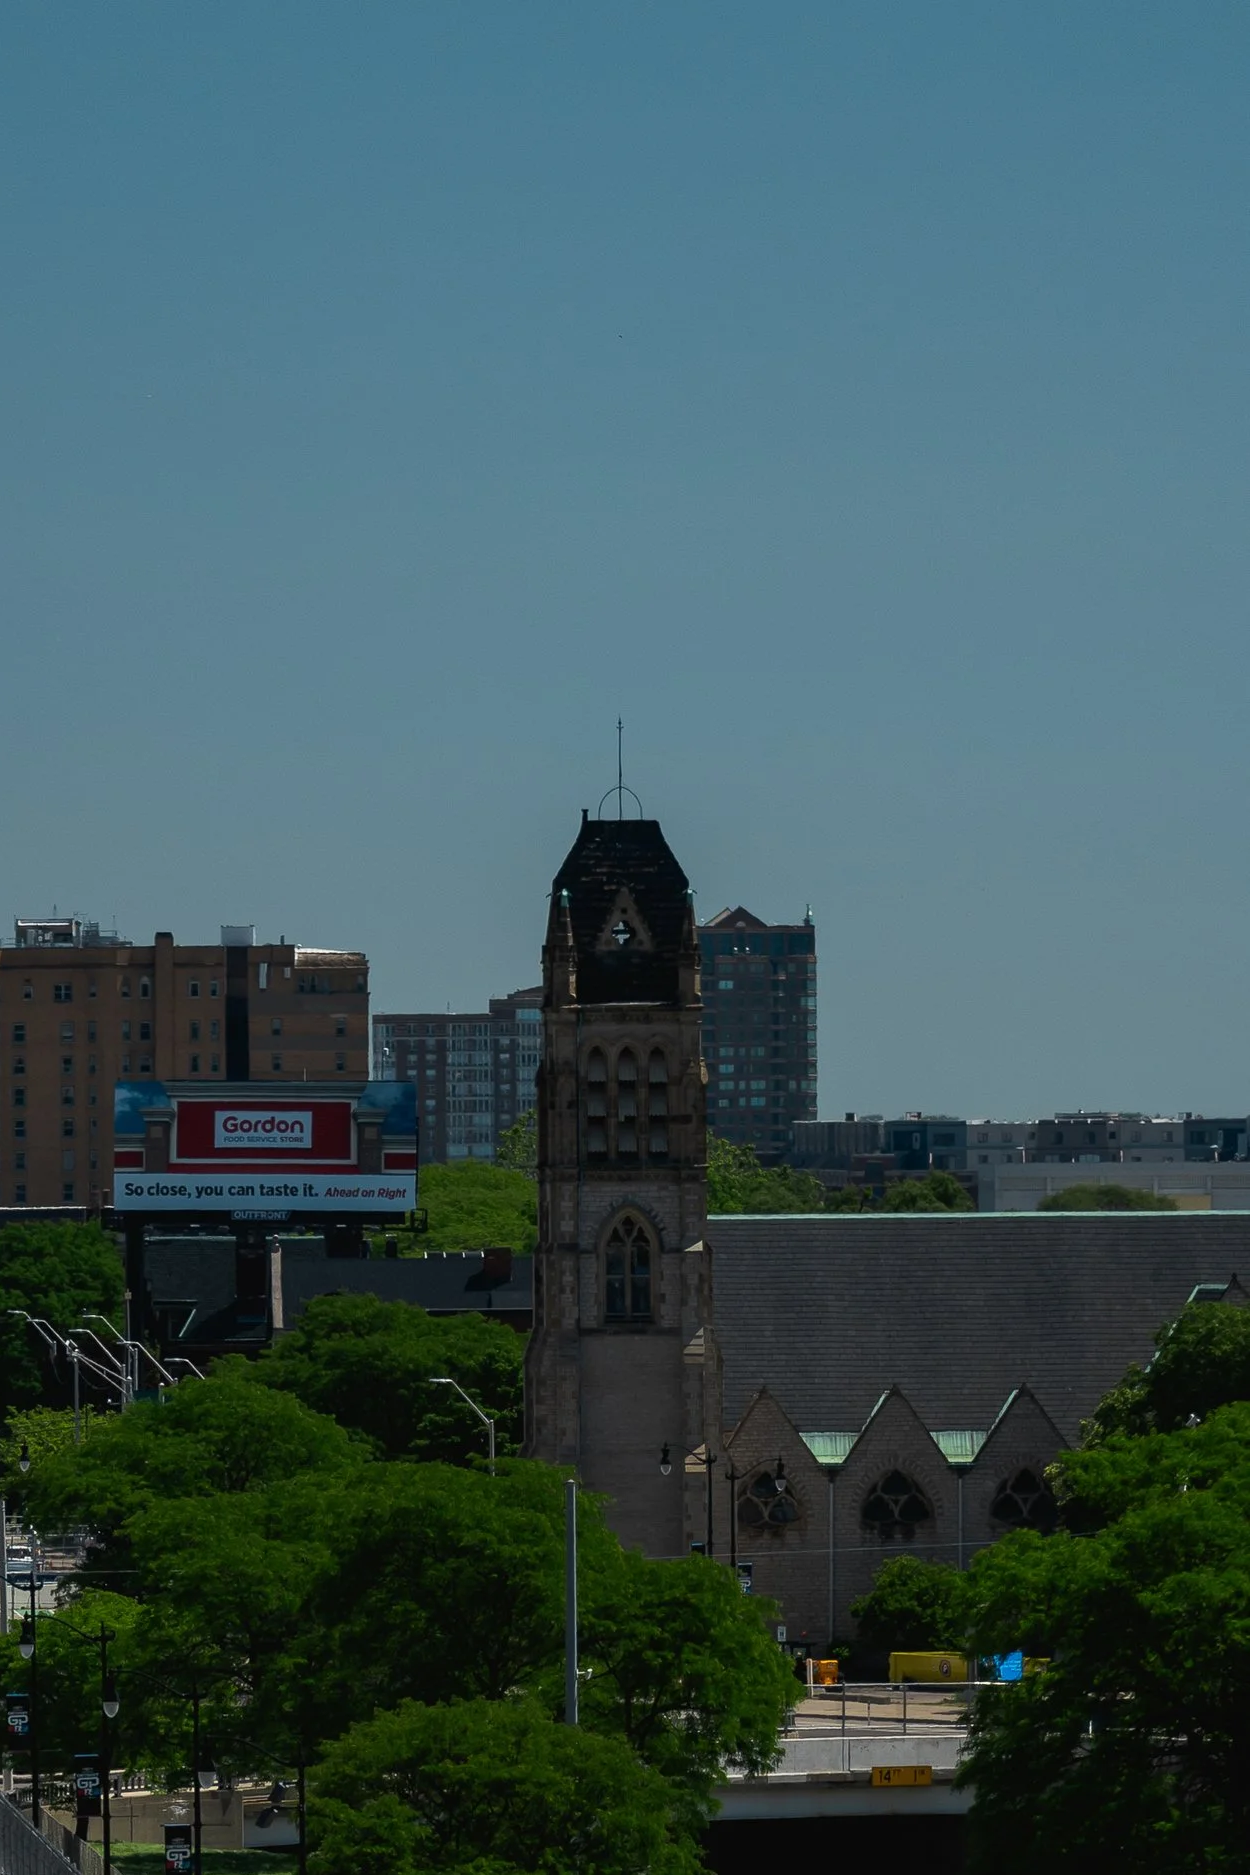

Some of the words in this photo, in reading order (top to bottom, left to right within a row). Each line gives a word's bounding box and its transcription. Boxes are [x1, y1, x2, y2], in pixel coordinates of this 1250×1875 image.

[222, 1115, 305, 1134] Gordon
[124, 1182, 144, 1196] So
[147, 1182, 192, 1198] close,
[195, 1185, 224, 1199] you
[228, 1185, 255, 1196] can
[259, 1183, 298, 1196] taste
[302, 1183, 319, 1197] it.
[324, 1187, 360, 1198] Ahead
[361, 1189, 375, 1198] on
[377, 1187, 407, 1200] Right
[234, 1211, 288, 1220] OUTFRONT
[7, 1715, 29, 1726] GP
[77, 1777, 100, 1789] GP
[166, 1849, 191, 1861] GP
